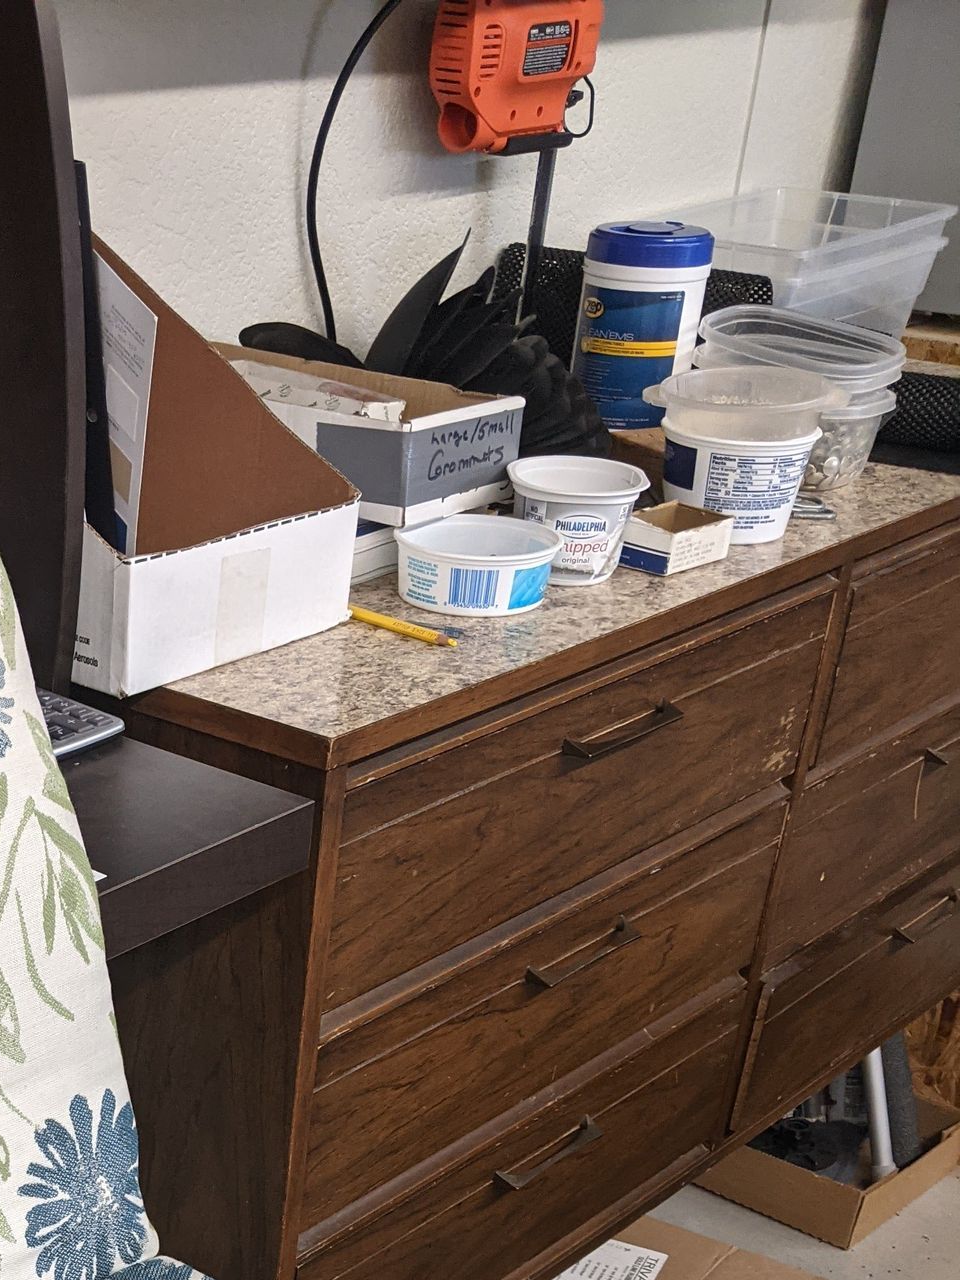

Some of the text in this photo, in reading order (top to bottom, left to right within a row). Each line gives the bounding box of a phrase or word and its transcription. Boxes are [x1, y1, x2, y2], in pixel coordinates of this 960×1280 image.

[530, 505, 539, 514] NO
[555, 519, 607, 533] PHILADELPHIA
[559, 540, 609, 556] ipped
[561, 556, 590, 565] original
[74, 652, 99, 667] Aerosols
